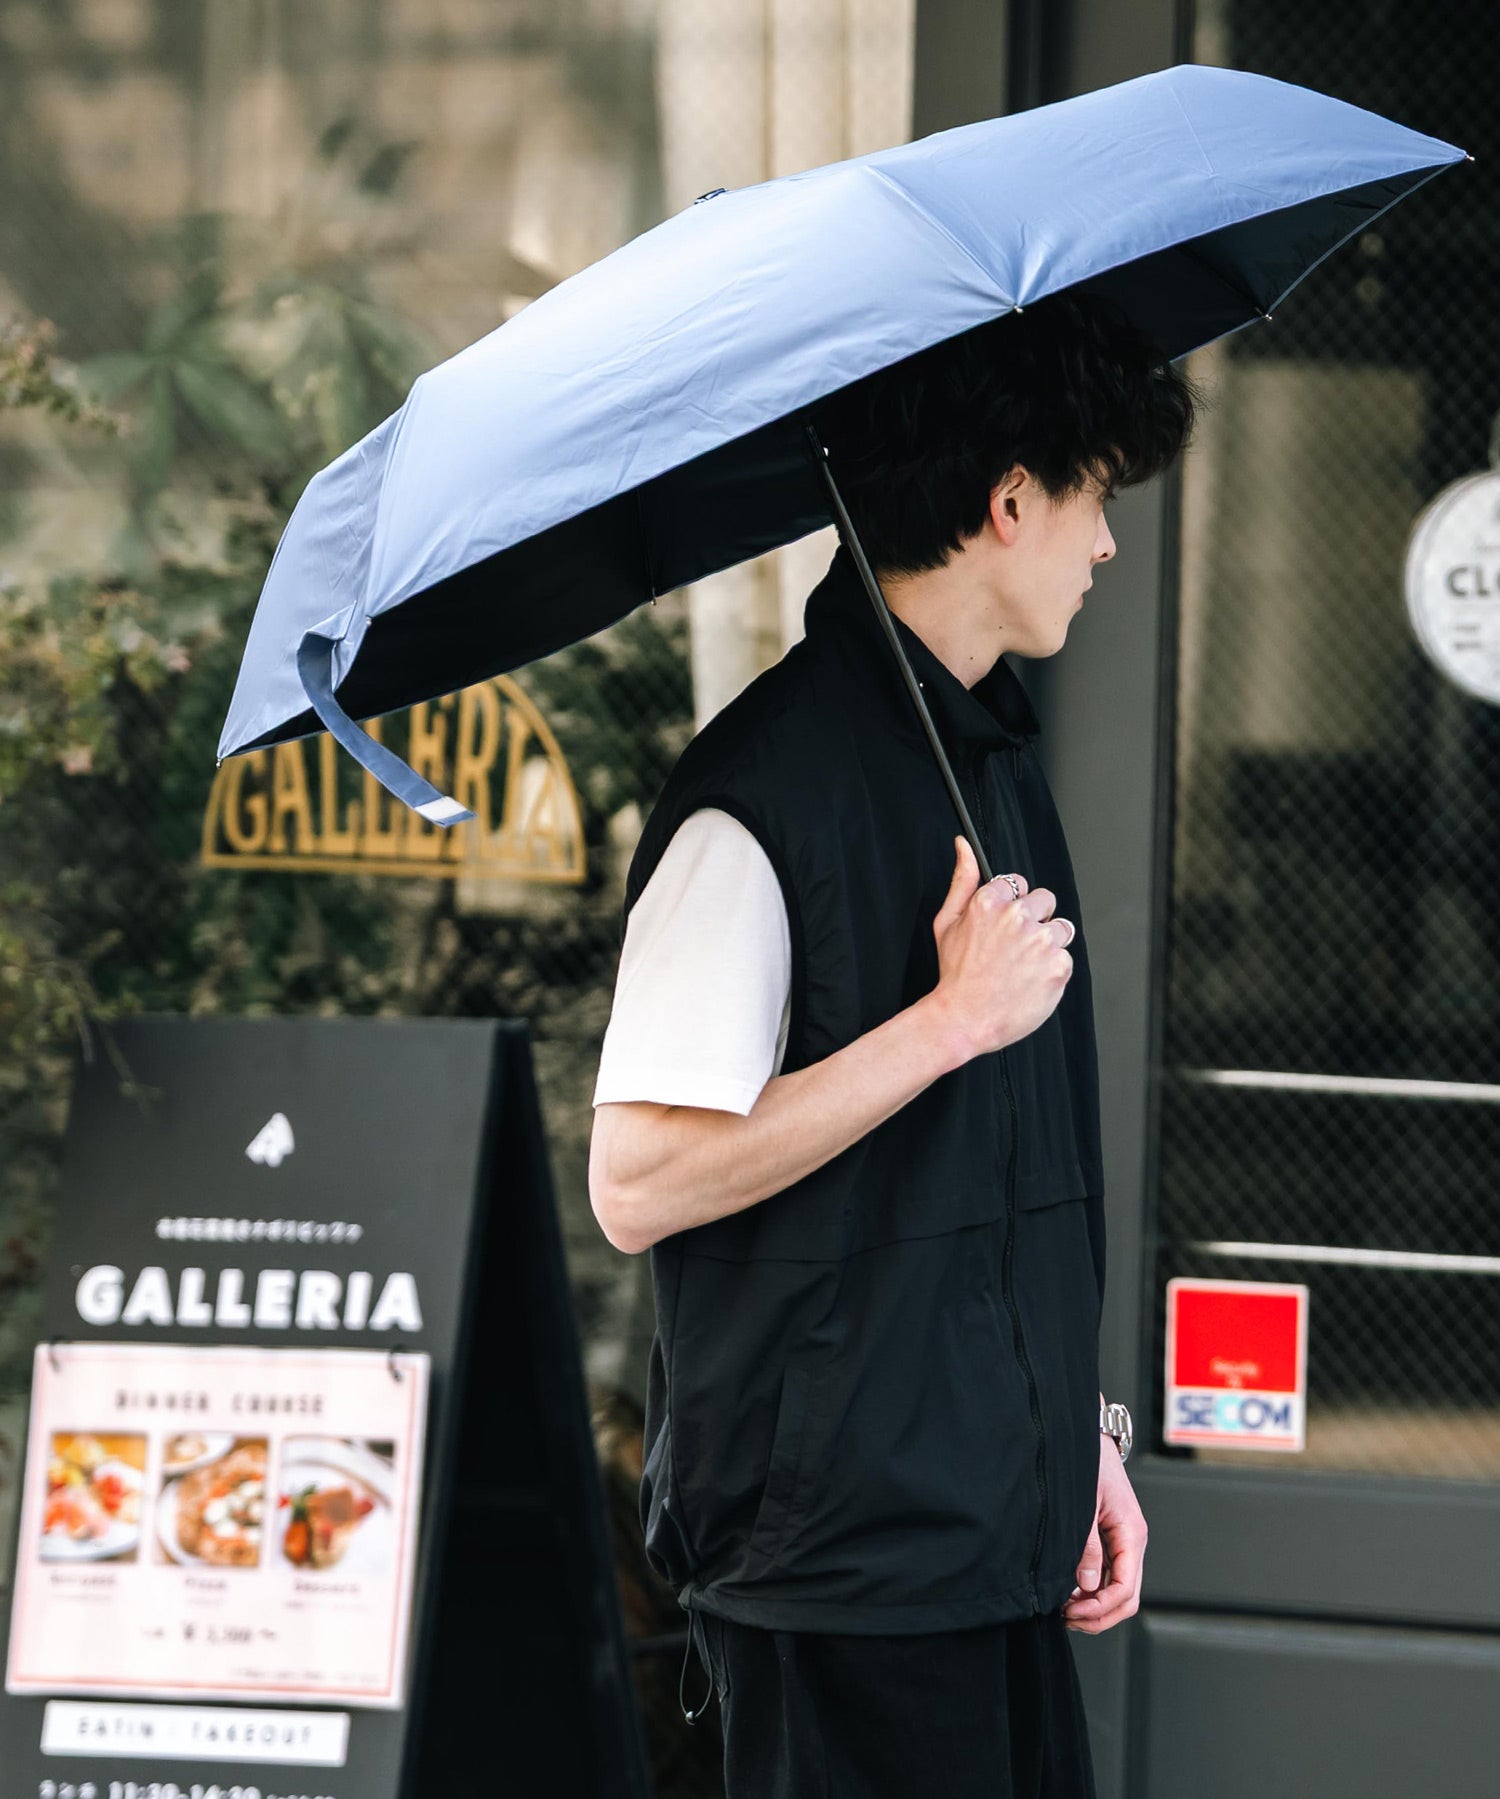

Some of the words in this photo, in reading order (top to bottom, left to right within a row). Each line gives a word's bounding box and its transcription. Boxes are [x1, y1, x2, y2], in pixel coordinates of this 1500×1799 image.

[1447, 566, 1500, 597] CL
[75, 1264, 423, 1332] GALLERIA
[1176, 1394, 1291, 1431] SECOM
